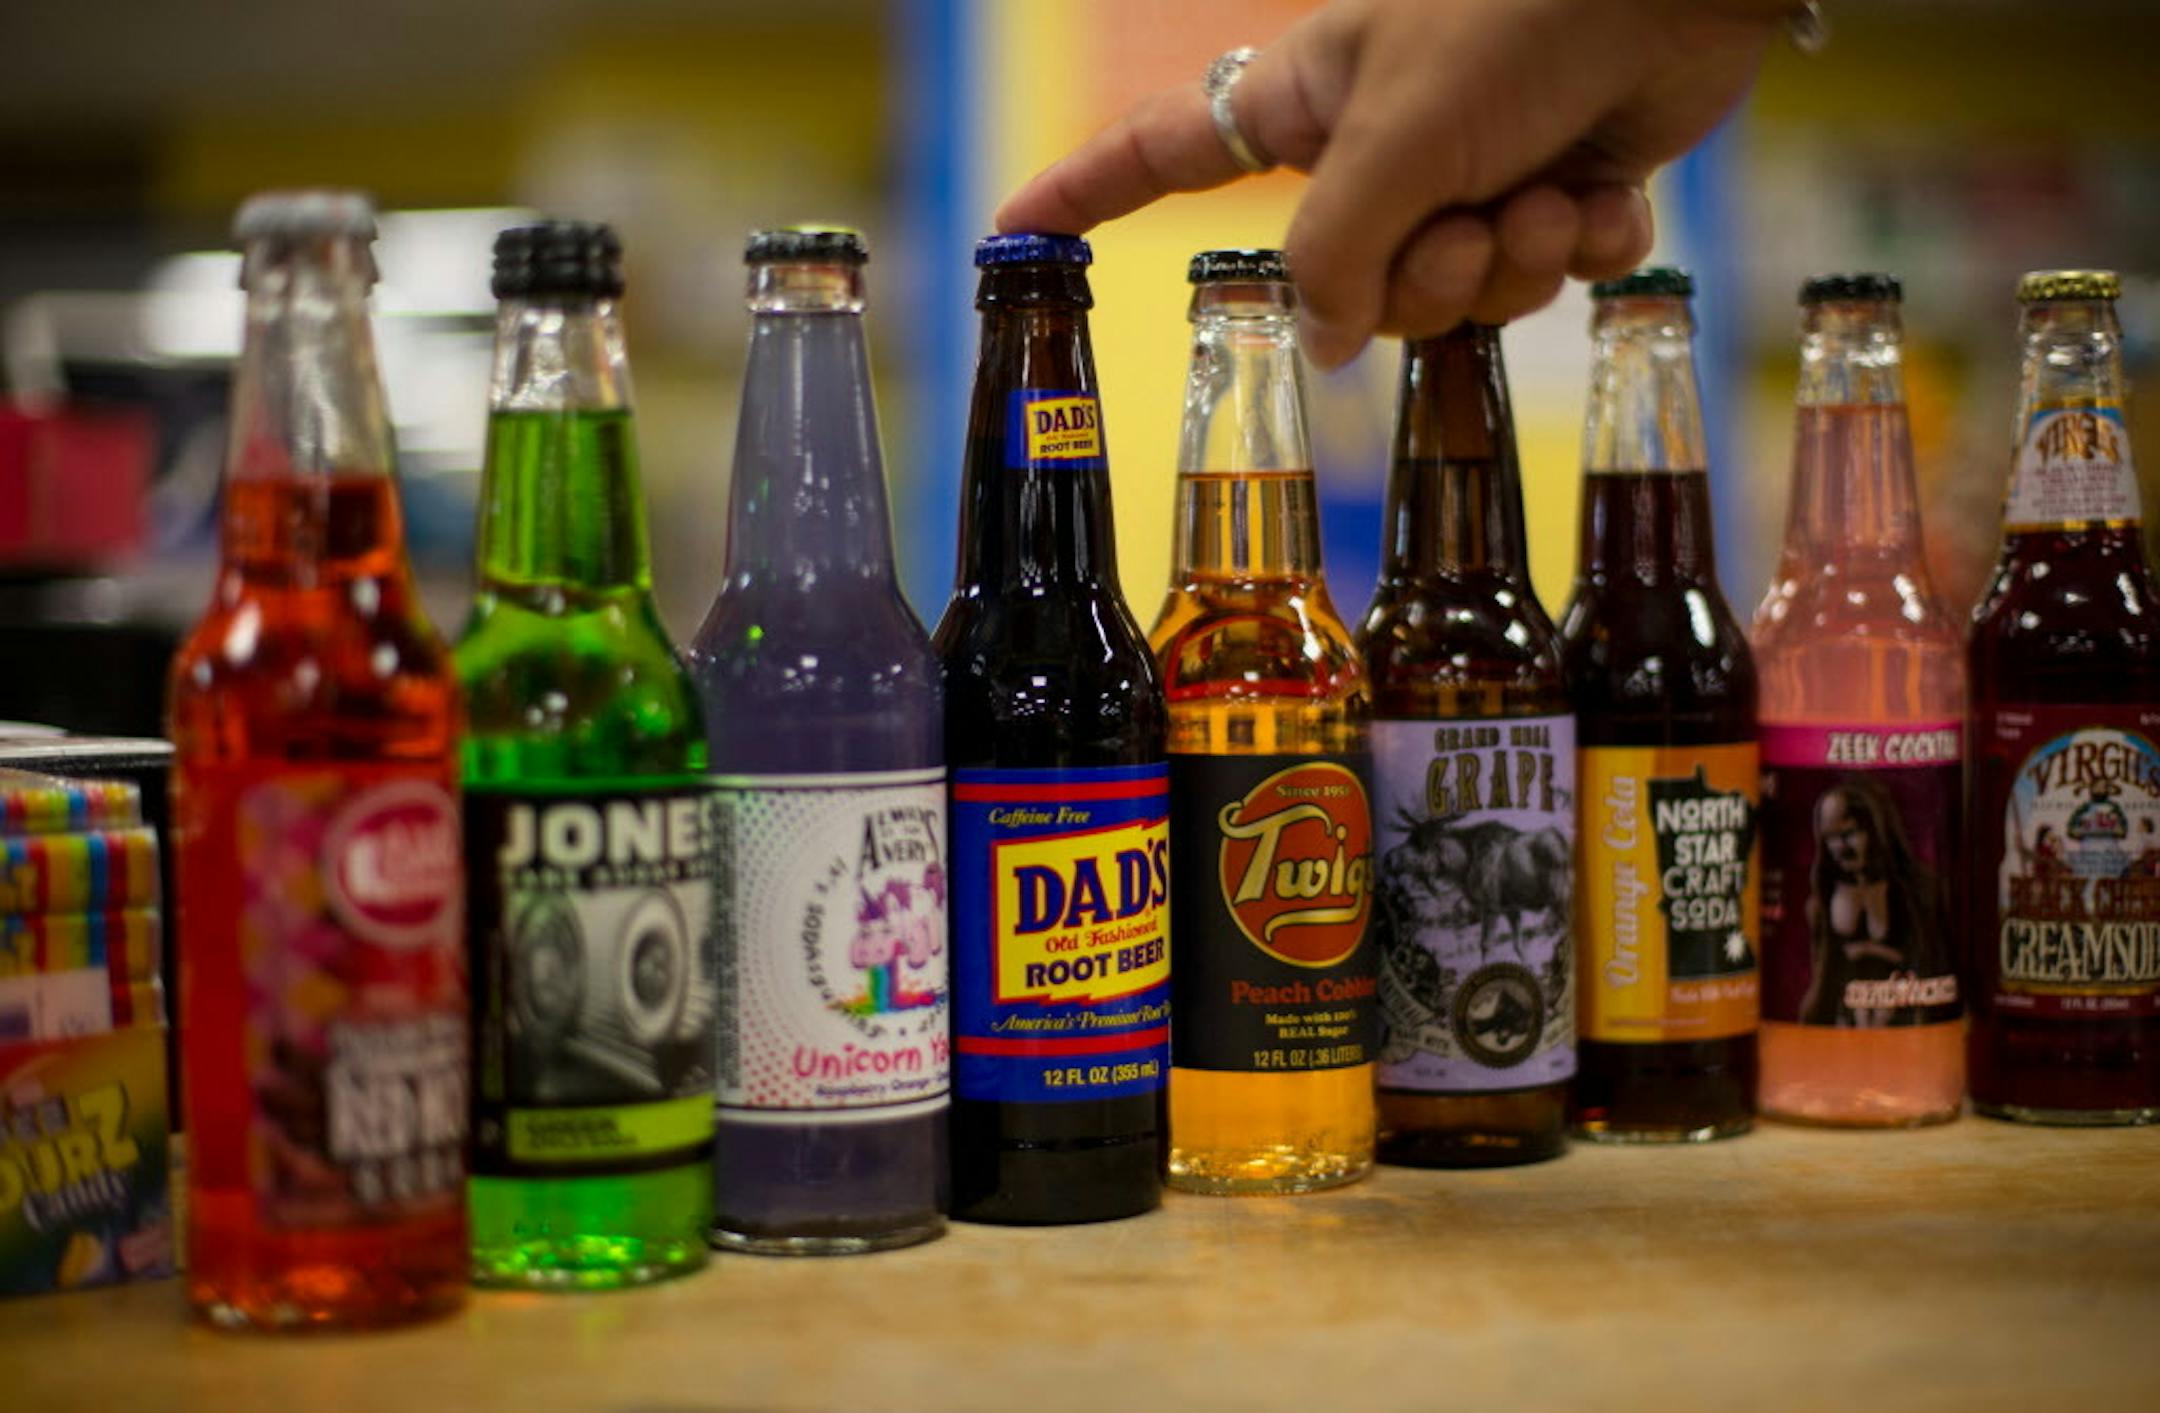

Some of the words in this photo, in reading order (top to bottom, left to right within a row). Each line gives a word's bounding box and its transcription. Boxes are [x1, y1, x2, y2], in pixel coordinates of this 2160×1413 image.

[1035, 403, 1095, 434] DAD'S
[1434, 726, 1500, 753] GRAND
[1276, 785, 1319, 798] Since
[1426, 750, 1556, 816] GRAPE
[989, 807, 1053, 828] Caffeine
[1056, 805, 1091, 824] Free
[1656, 797, 1746, 834] NORTH
[1674, 832, 1736, 866] STAR
[1013, 837, 1168, 935] DAD'S
[1662, 862, 1745, 898] CRAFT
[1670, 898, 1739, 931] SODA
[1046, 934, 1078, 953] Old
[1086, 916, 1157, 947] Fashioned
[1026, 952, 1112, 988] ROOT
[1118, 936, 1165, 974] BEER
[1231, 979, 1311, 1004] Peach
[991, 1011, 1074, 1032] America's
[793, 1043, 921, 1078] Unicorn
[1253, 1050, 1269, 1067] 12
[1271, 1049, 1287, 1067] FL
[1290, 1048, 1306, 1066] OZ
[1043, 1070, 1063, 1087] 12
[1066, 1068, 1085, 1085] FL
[1089, 1065, 1109, 1084] OZ
